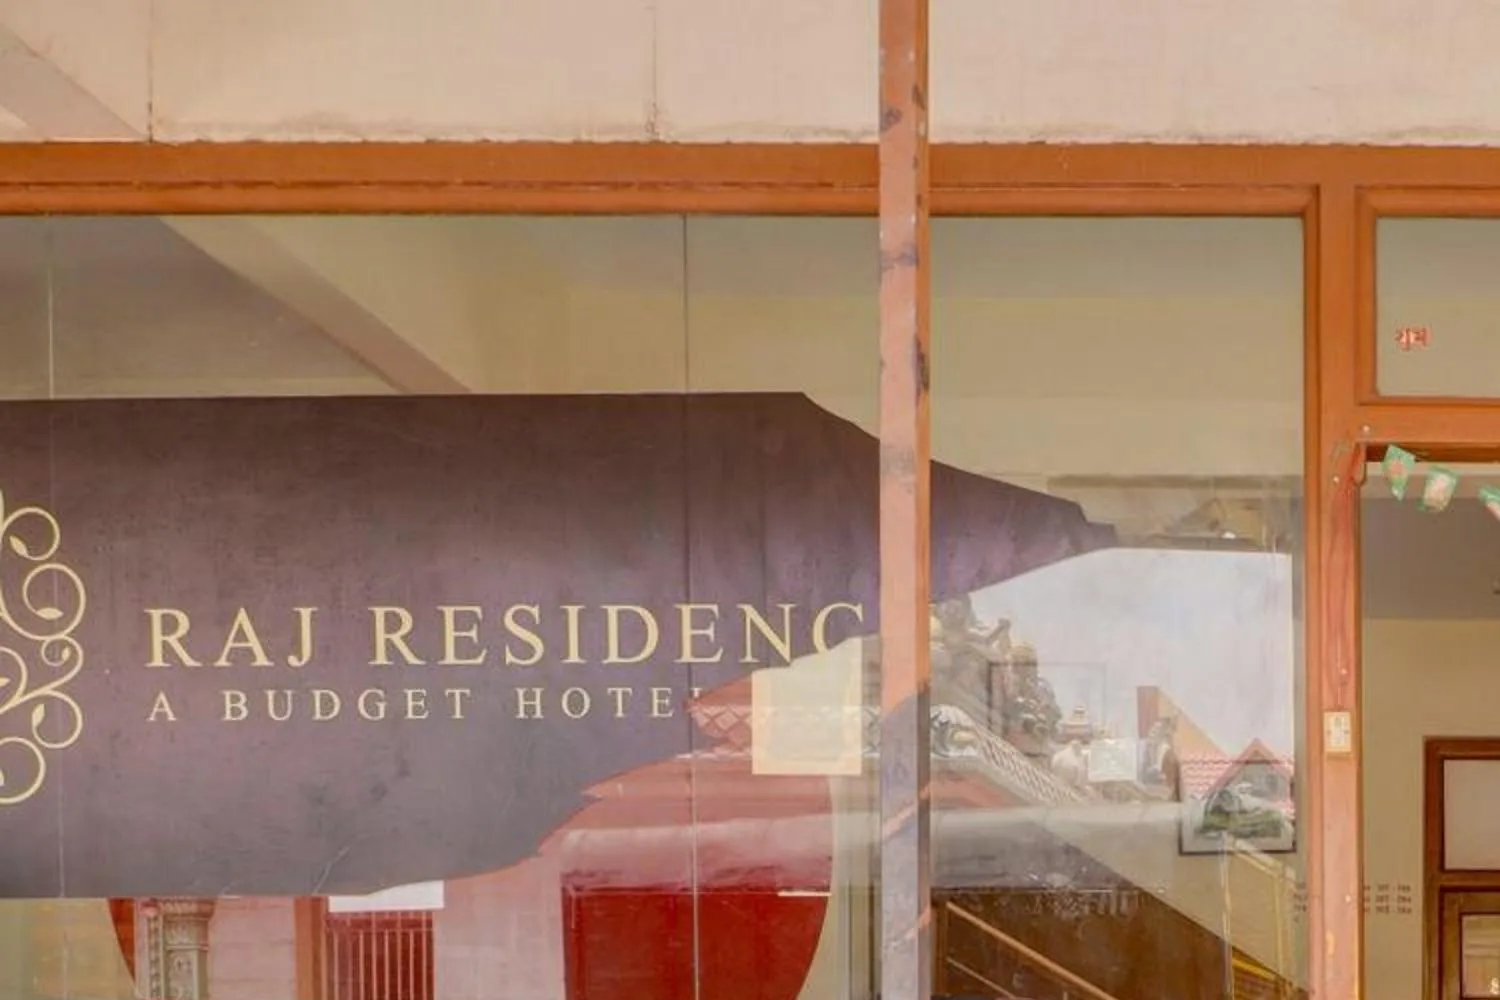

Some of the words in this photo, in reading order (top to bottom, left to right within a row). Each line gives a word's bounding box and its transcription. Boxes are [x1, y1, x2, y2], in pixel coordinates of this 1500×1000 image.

[144, 607, 319, 668] RAJ
[150, 691, 177, 721] A
[223, 688, 471, 721] BUDGET
[515, 687, 703, 719] HOTE
